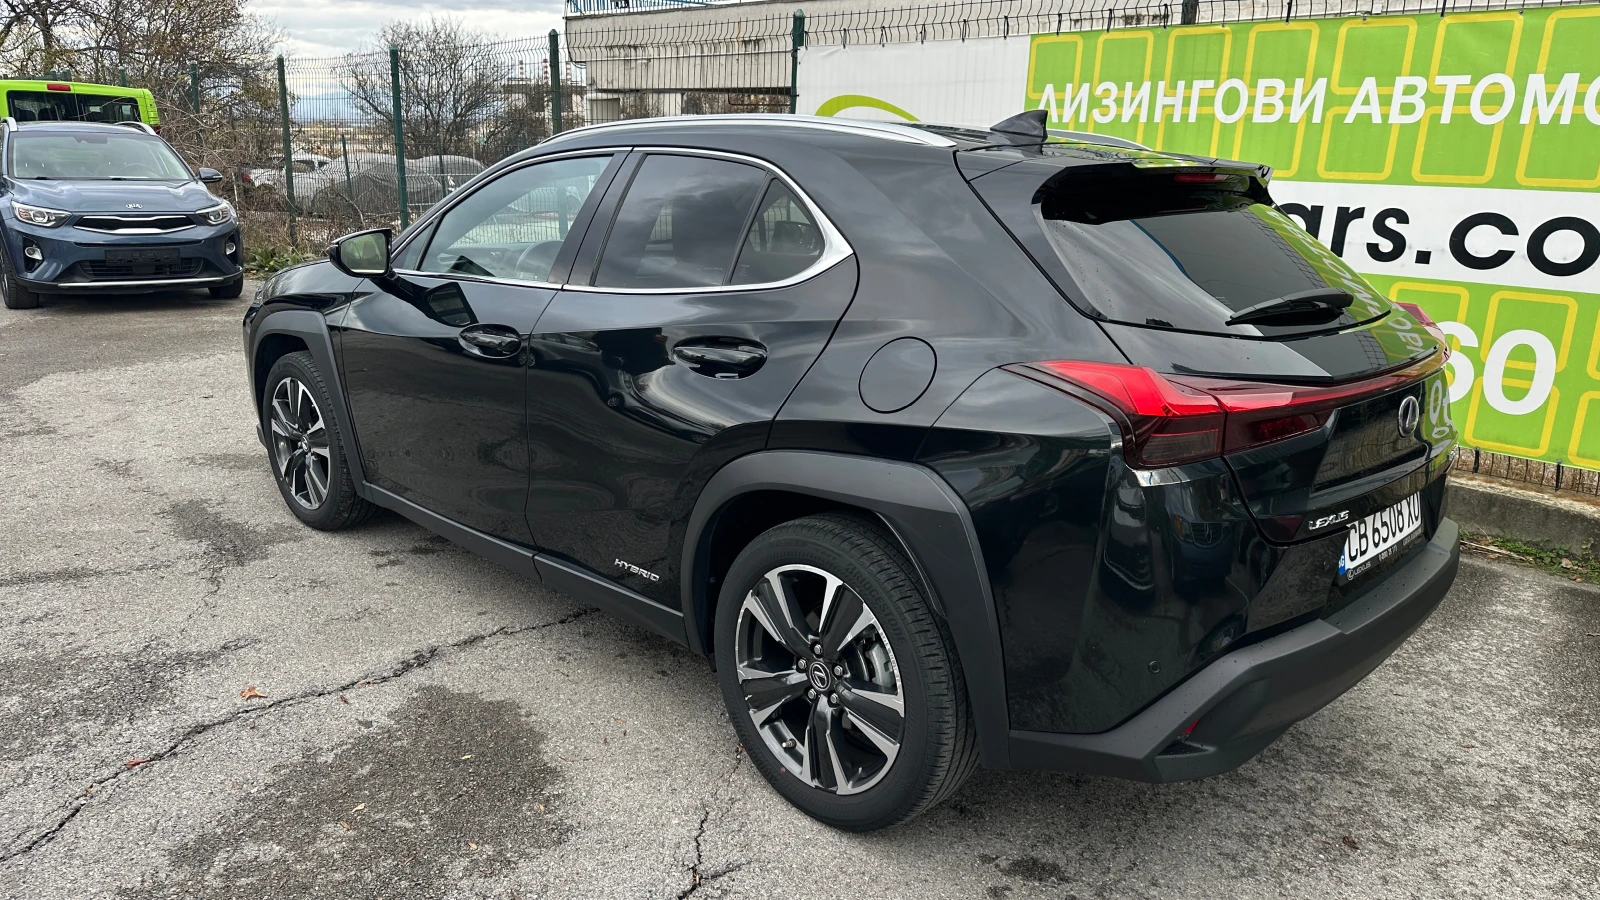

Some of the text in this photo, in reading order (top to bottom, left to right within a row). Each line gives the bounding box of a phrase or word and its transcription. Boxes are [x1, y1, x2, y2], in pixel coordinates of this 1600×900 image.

[1037, 78, 1328, 124] ЛИЗИНГОВИ
[1308, 510, 1350, 530] LEXUS
[1372, 502, 1405, 548] 6508
[613, 557, 660, 582] HYBRID
[844, 562, 906, 645] BRIDGESTONE
